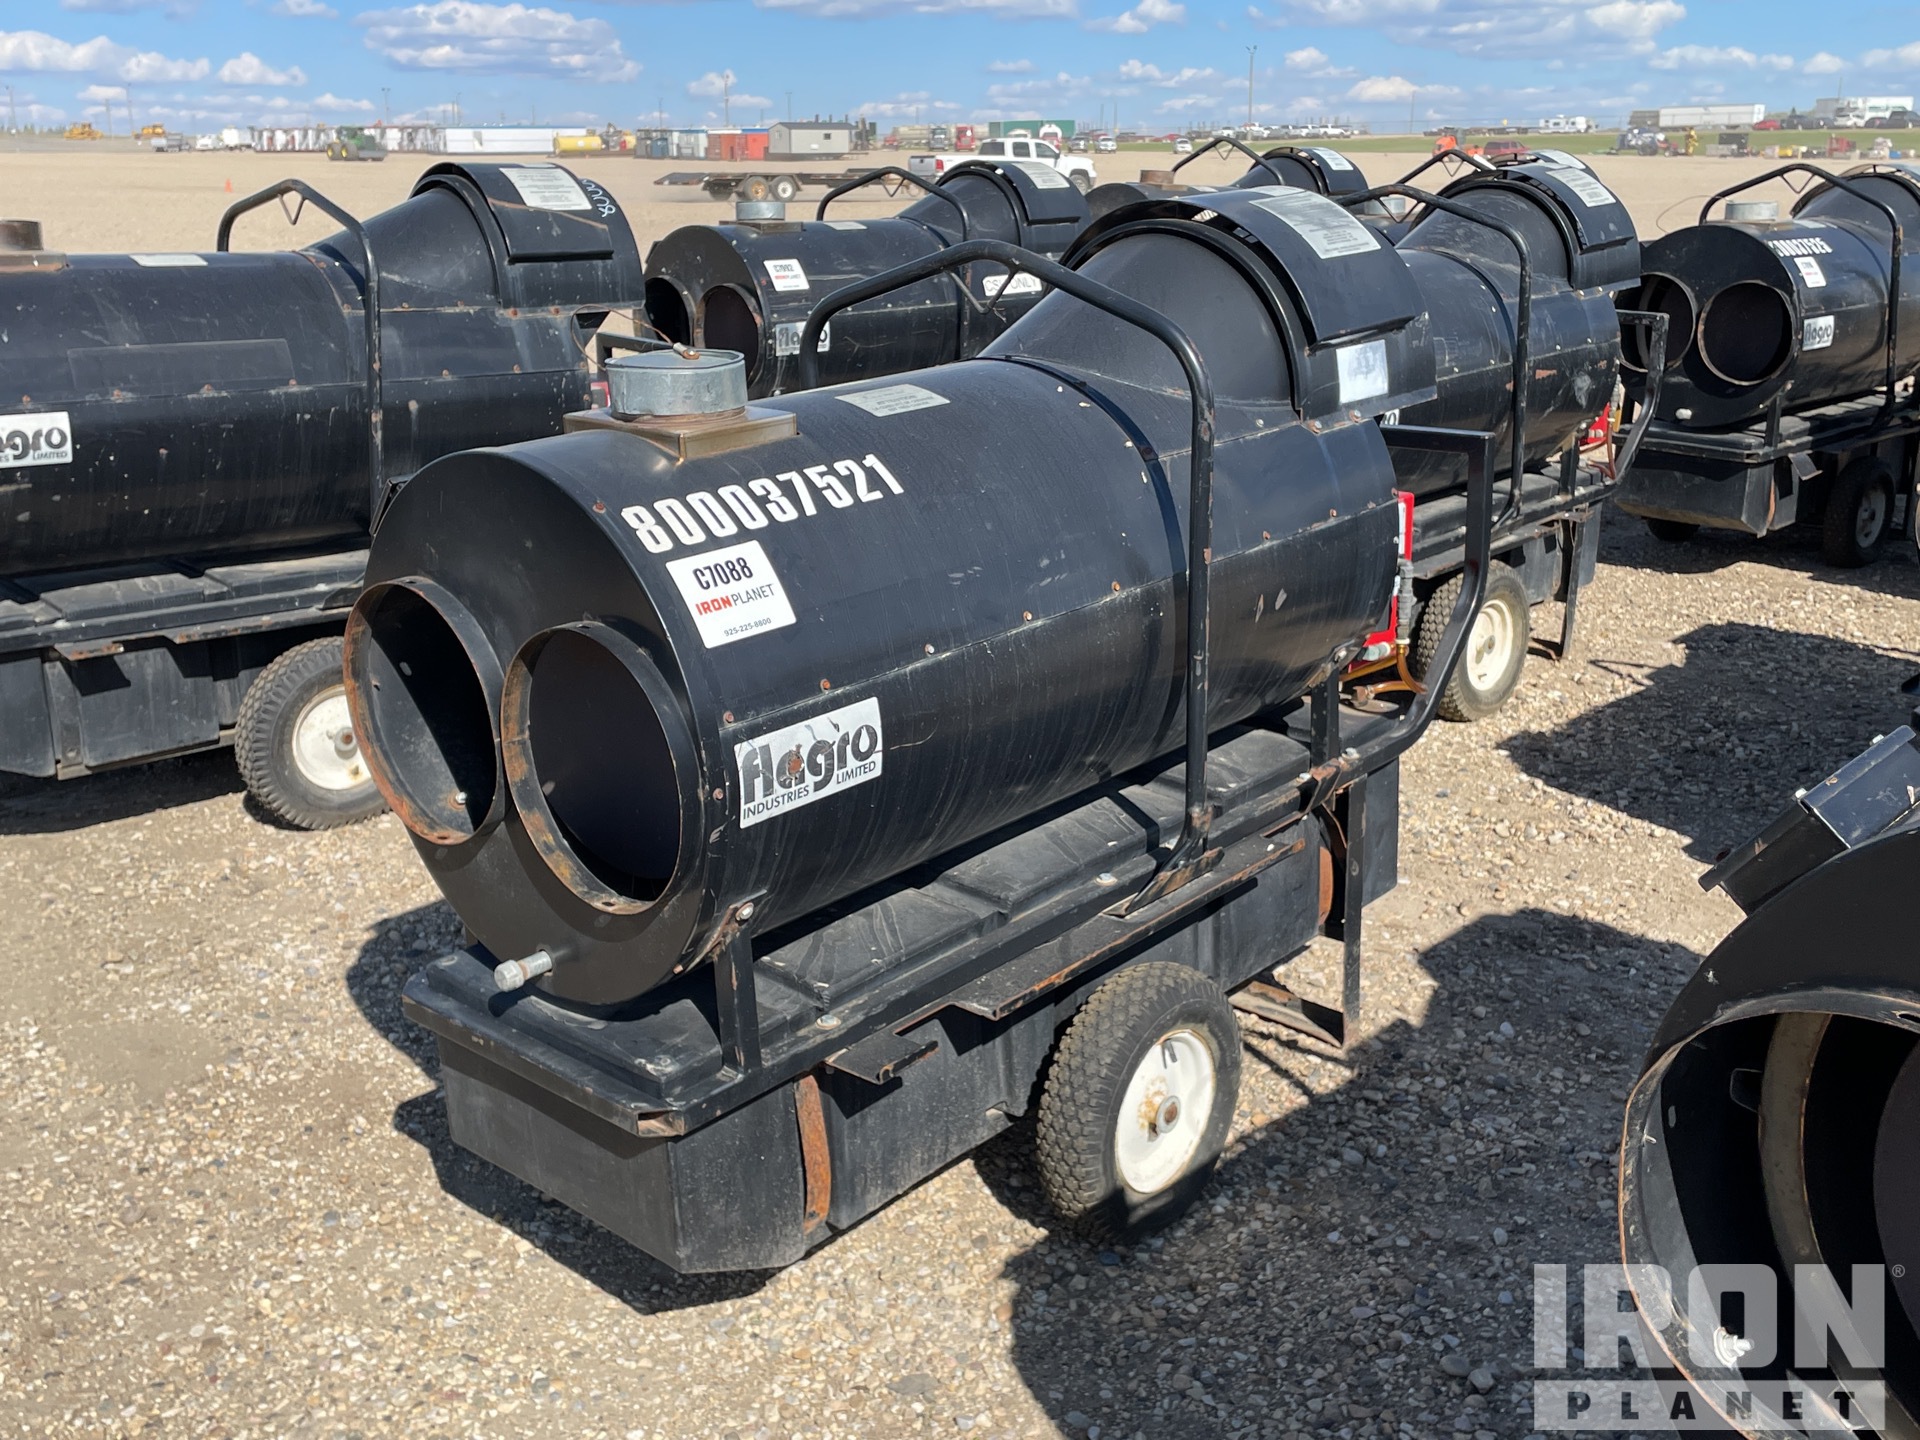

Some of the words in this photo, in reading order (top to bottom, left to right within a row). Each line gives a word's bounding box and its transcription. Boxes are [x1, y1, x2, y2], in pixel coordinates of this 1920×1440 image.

[984, 278, 1004, 292] CS
[1010, 276, 1037, 290] ONLY
[0, 426, 68, 461] gro
[620, 453, 905, 554] 800037521
[692, 557, 754, 590] C7088
[695, 583, 775, 616] IRONPLANET
[723, 617, 772, 637] 925-225-8800
[741, 724, 878, 806] flagro
[742, 785, 810, 820] INDUSTRIES
[836, 760, 877, 785] LIMITED
